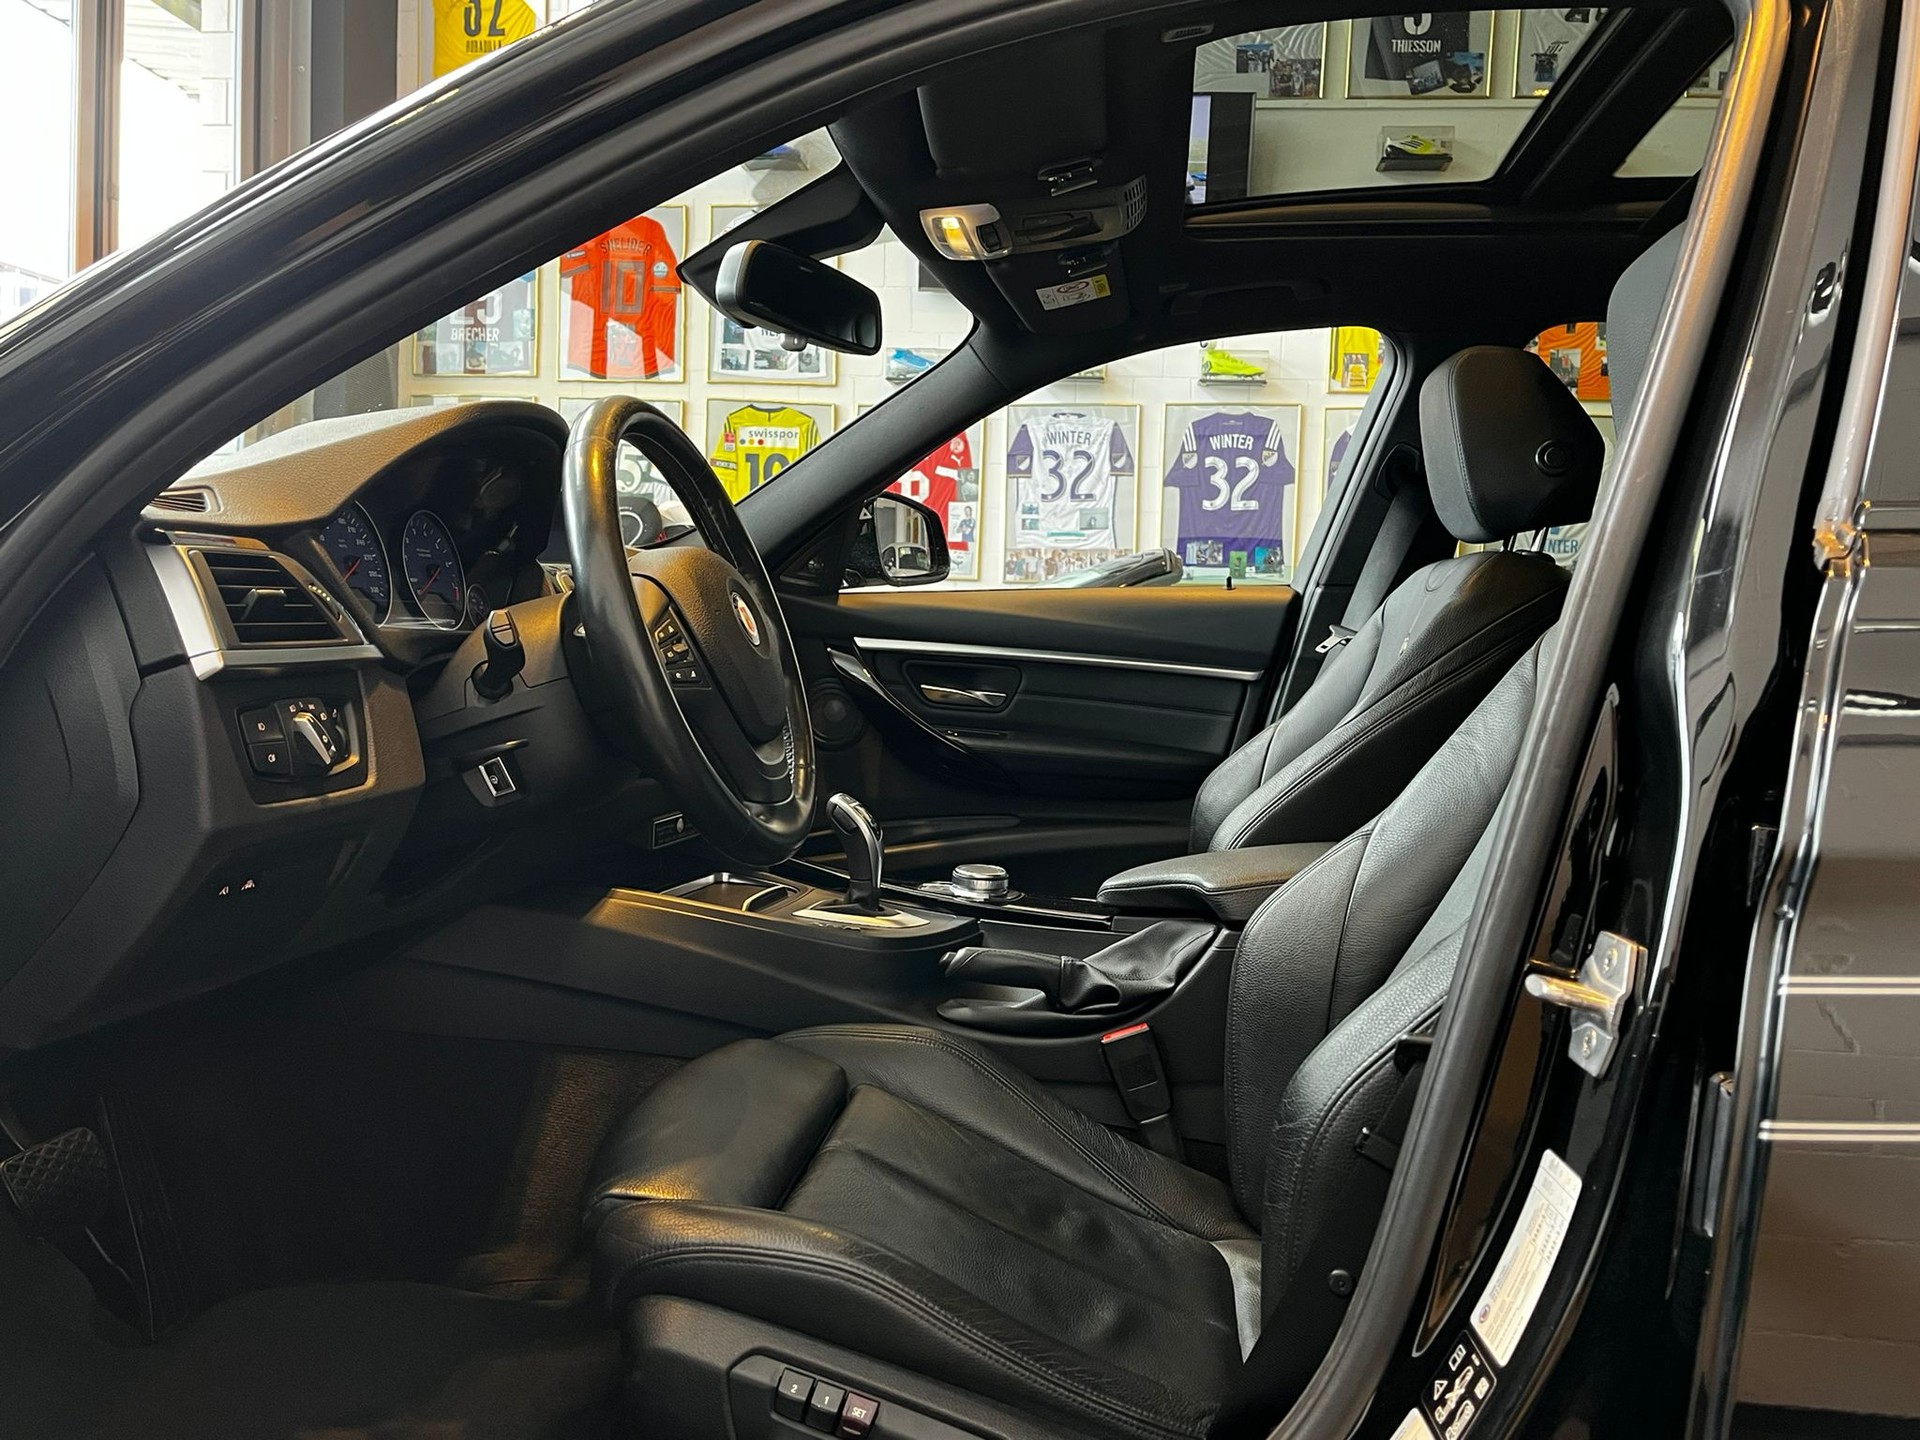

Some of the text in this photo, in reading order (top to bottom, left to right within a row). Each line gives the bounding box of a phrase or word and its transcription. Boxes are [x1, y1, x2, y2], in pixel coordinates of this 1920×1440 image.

[1391, 39, 1441, 53] THIESSON
[601, 259, 646, 315] 10
[450, 327, 500, 342] BRECHER
[748, 428, 799, 441] swisspor
[1046, 430, 1092, 446] WINTER
[1209, 433, 1254, 451] WINTER
[1041, 449, 1097, 503] 32
[1202, 456, 1260, 511] 32
[1547, 539, 1578, 554] NTER
[790, 1384, 798, 1394] 2
[851, 1406, 867, 1419] SET
